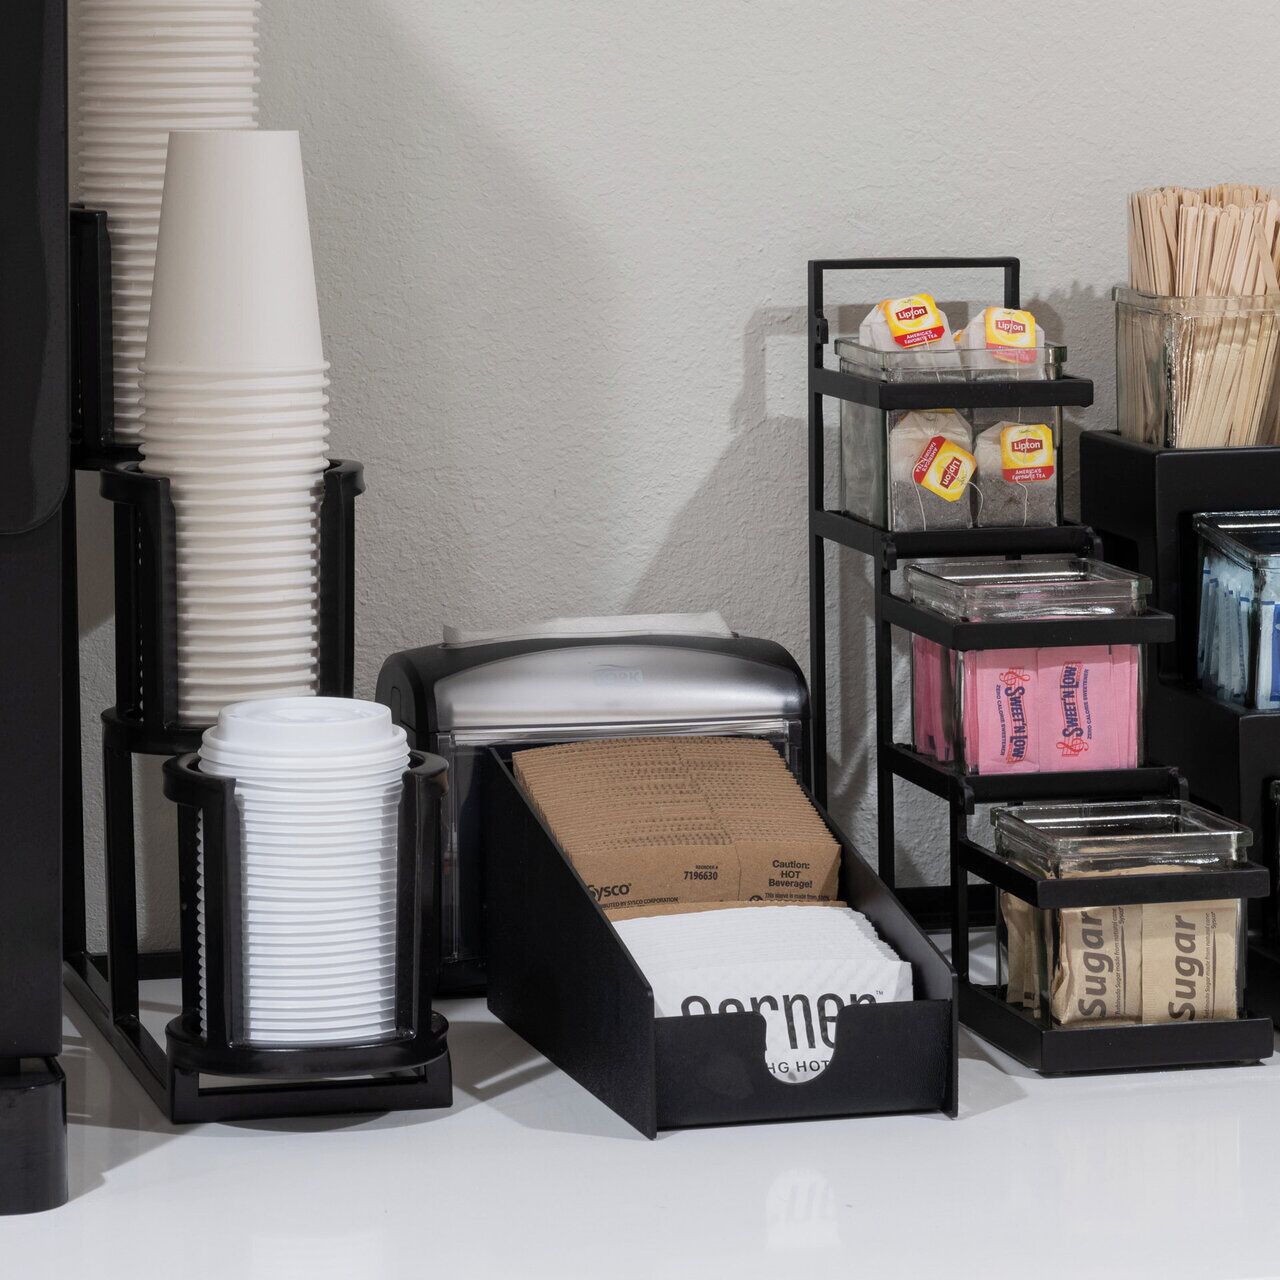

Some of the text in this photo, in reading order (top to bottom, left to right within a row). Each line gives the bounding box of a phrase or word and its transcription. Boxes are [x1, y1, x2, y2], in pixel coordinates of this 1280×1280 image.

[1014, 440, 1041, 451] Lipton
[1060, 666, 1080, 689] LOW
[1010, 735, 1028, 758] LOW
[772, 859, 810, 869] Caution:
[683, 871, 718, 881] 7196630
[781, 870, 801, 879] HOT
[768, 878, 813, 890] Beverage!
[1078, 911, 1114, 1017] Sugar
[1168, 914, 1204, 1020] Sugar
[681, 993, 877, 1049] rne
[768, 1060, 829, 1073] HG HOT
